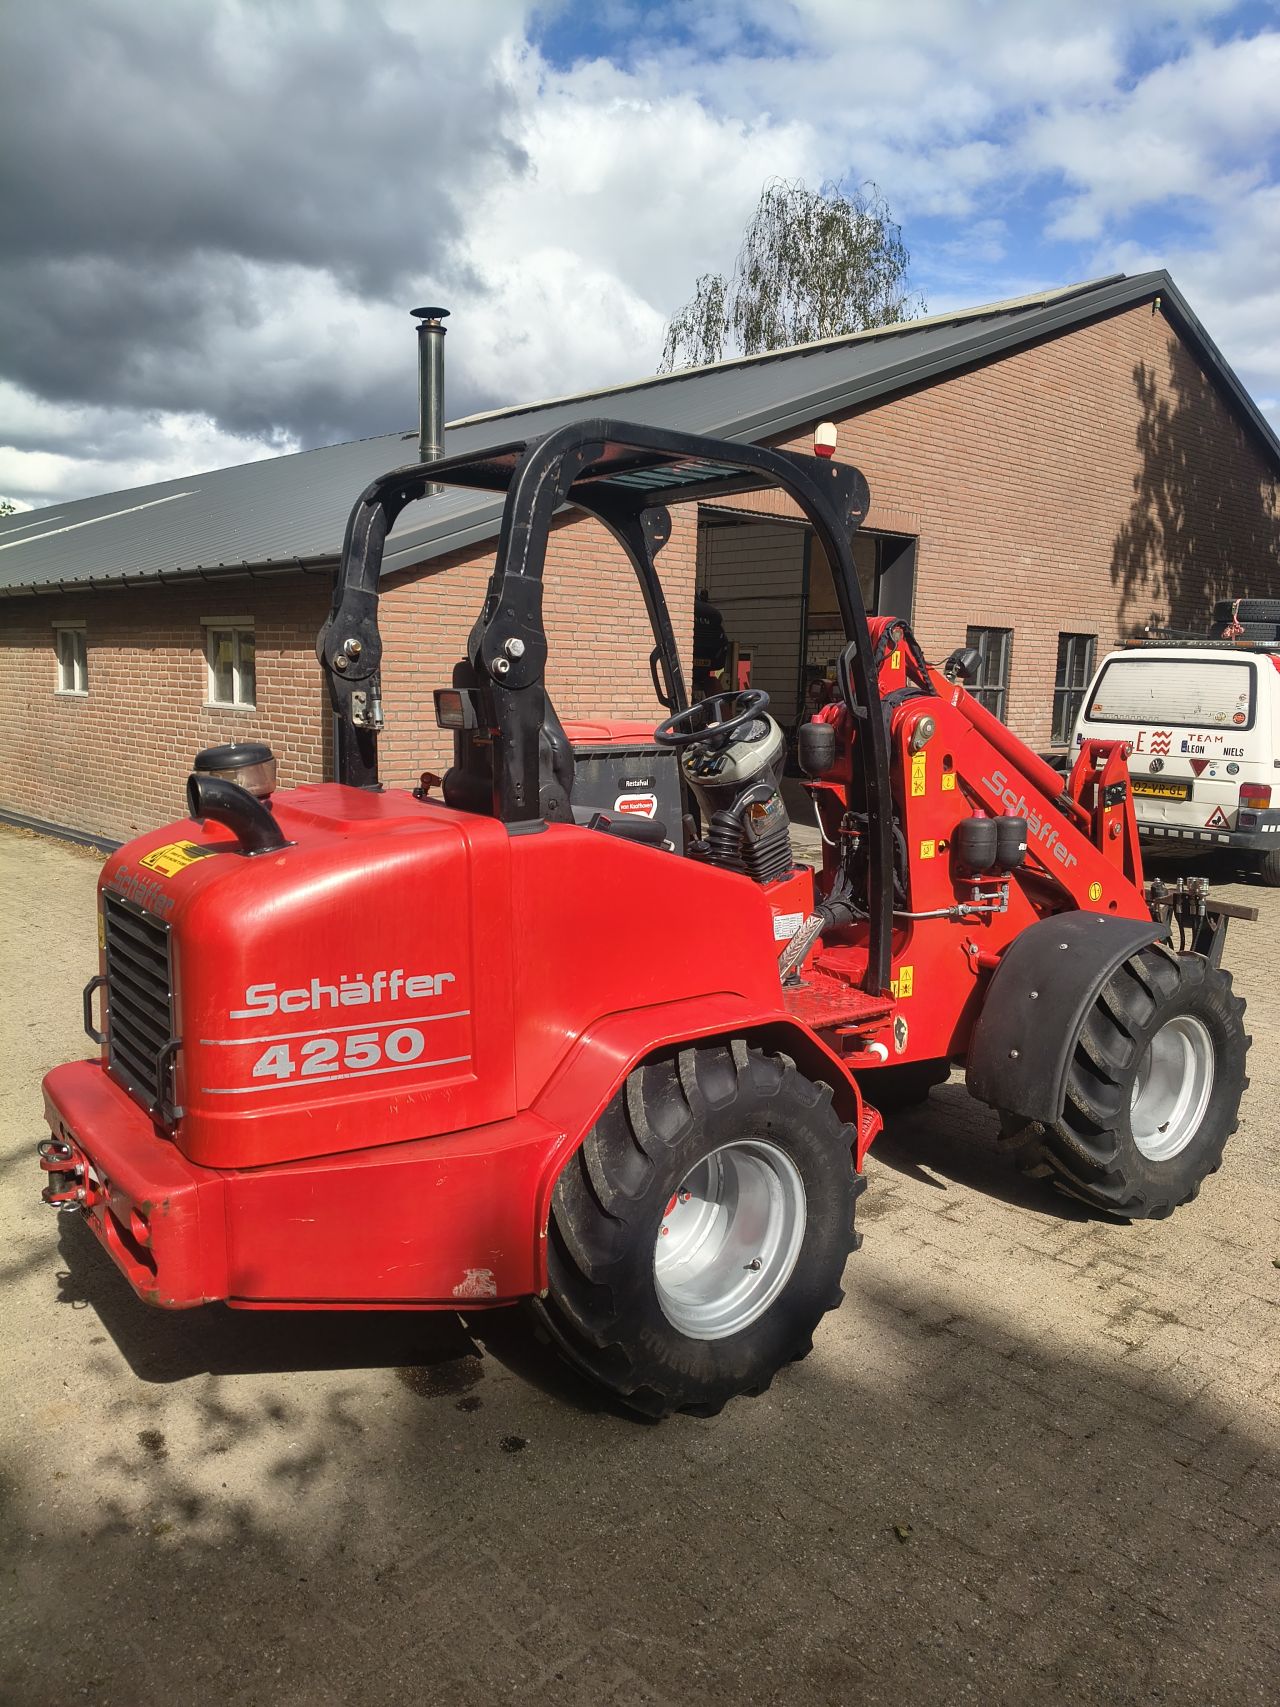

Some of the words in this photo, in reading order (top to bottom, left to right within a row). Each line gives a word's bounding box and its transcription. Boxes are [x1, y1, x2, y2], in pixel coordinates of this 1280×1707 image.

[1187, 745, 1205, 754] LEON
[1223, 747, 1244, 757] NIELS
[1188, 734, 1223, 743] TEAM
[1134, 782, 1183, 796] 02-VR-GL
[981, 770, 1078, 868] Schäffer
[109, 865, 175, 917] Schäffer
[230, 969, 456, 1019] Schäffer
[252, 1028, 426, 1079] 4250
